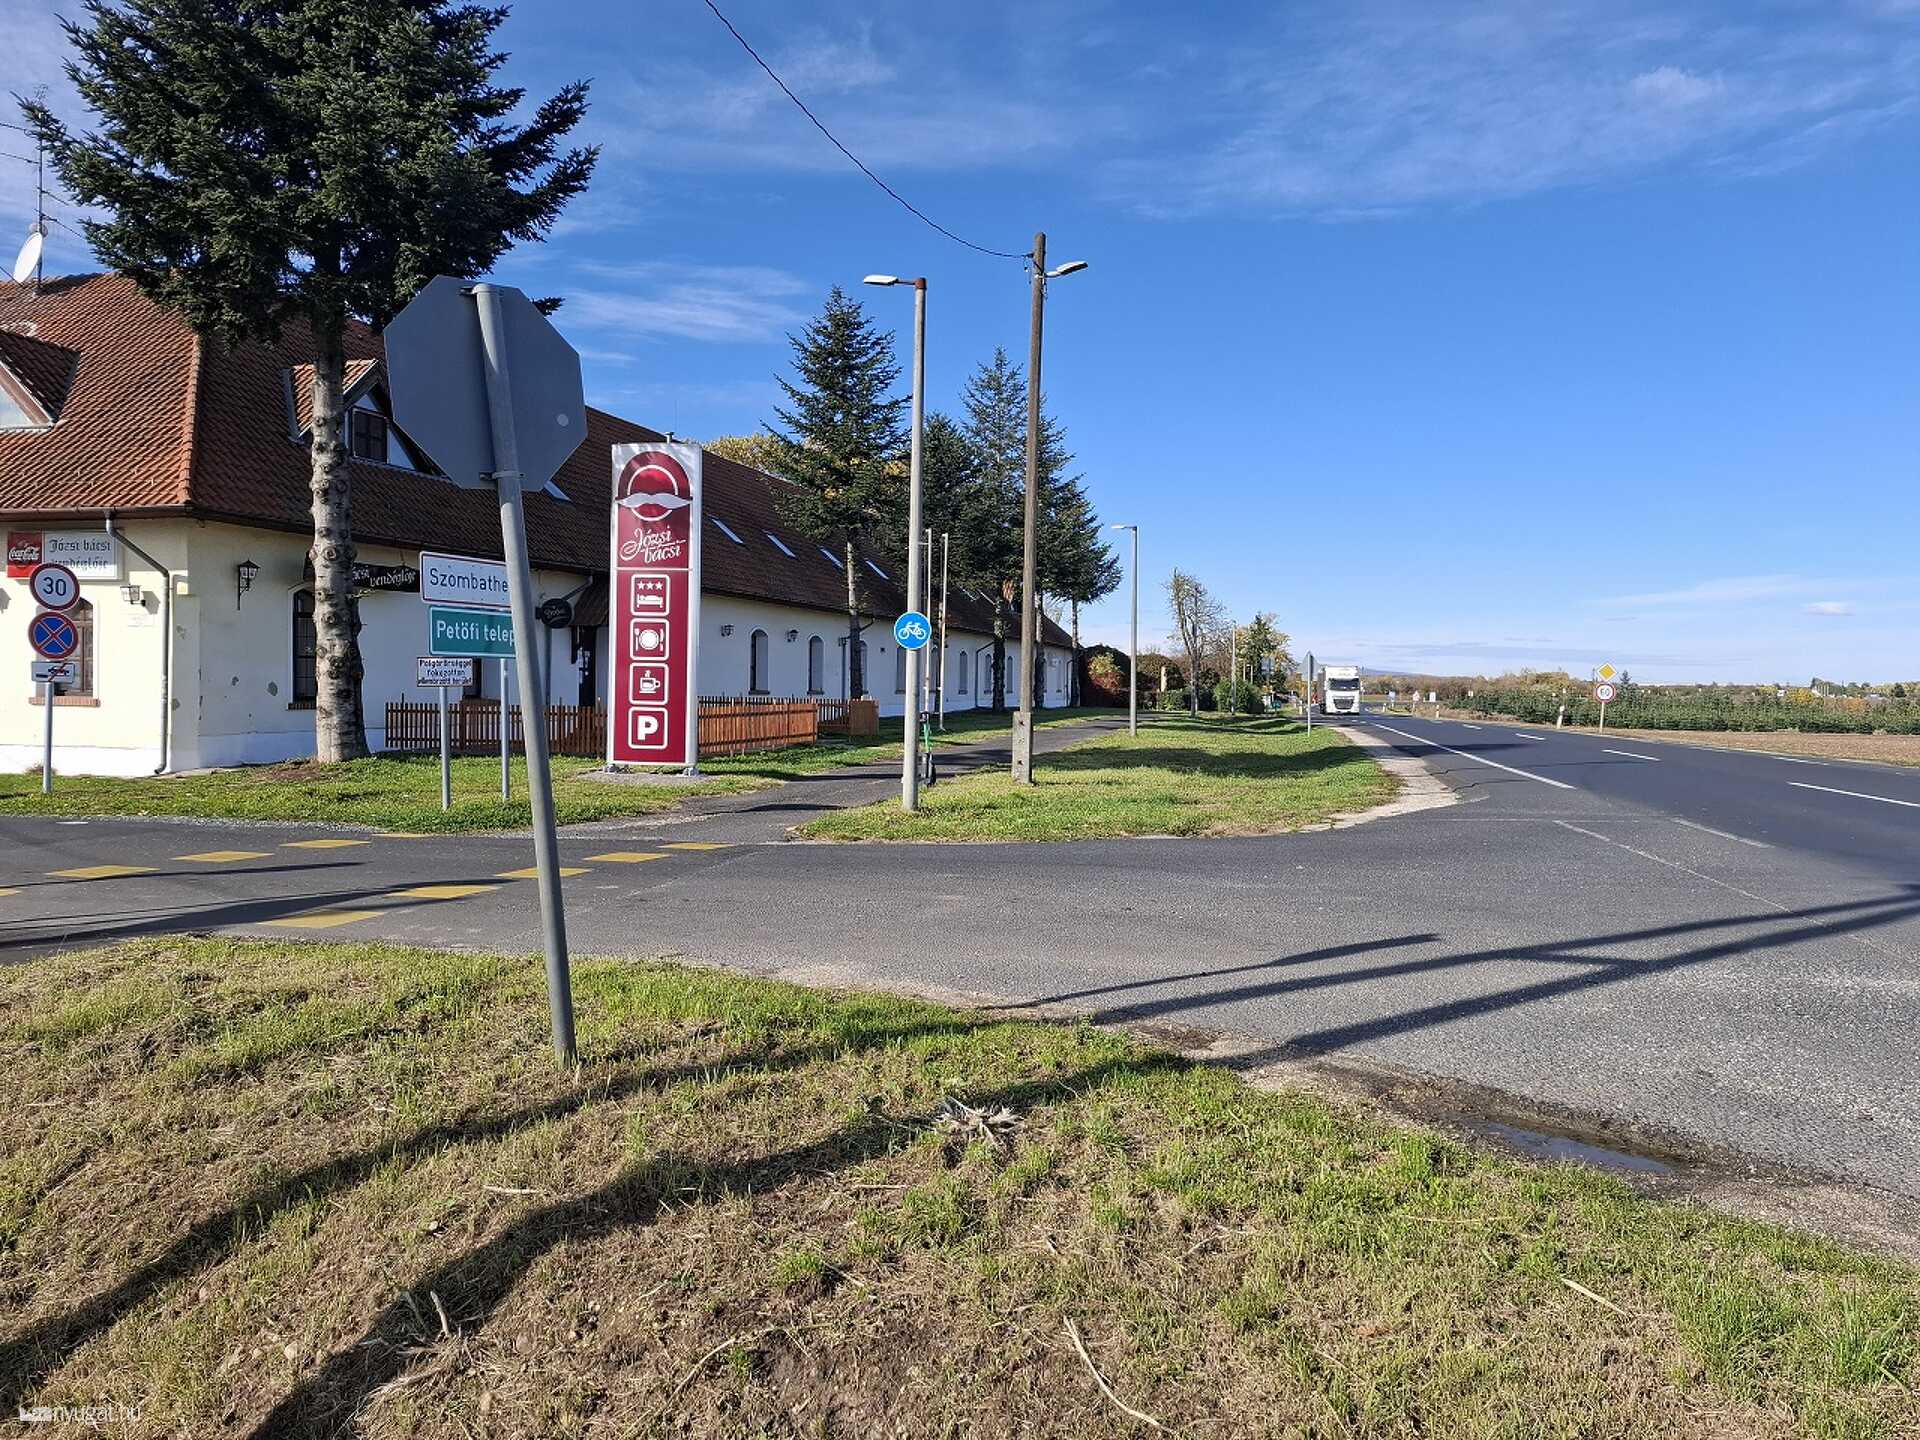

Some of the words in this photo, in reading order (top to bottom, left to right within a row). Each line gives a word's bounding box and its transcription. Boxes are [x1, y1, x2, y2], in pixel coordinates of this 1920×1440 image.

[8, 542, 40, 561] Coca-Cola
[49, 538, 80, 553] Józsi
[83, 539, 111, 551] bácsi
[620, 524, 671, 560] Józsi
[642, 541, 684, 563] bácsi
[42, 576, 67, 597] 30
[429, 567, 509, 592] Szombathe
[637, 716, 658, 740] P
